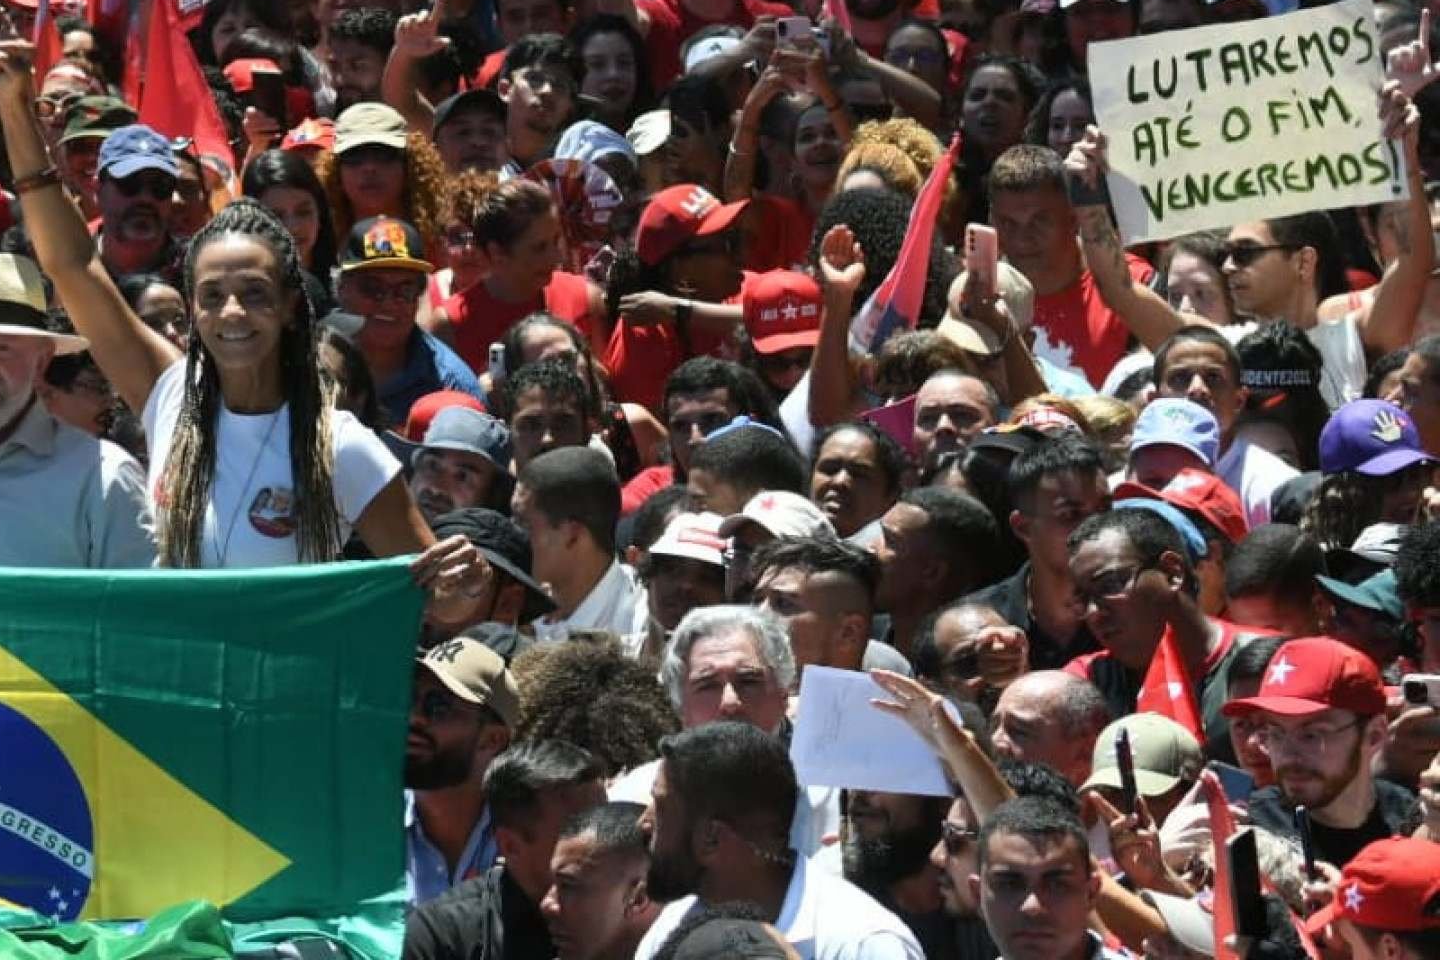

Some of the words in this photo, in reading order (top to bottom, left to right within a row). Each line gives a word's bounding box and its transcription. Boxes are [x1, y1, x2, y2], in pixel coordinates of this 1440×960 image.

[1127, 16, 1373, 104] LUTAREMOS
[1133, 100, 1201, 167] ATÉ
[1221, 106, 1251, 142] O
[1140, 139, 1401, 221] VENCEREMOS!
